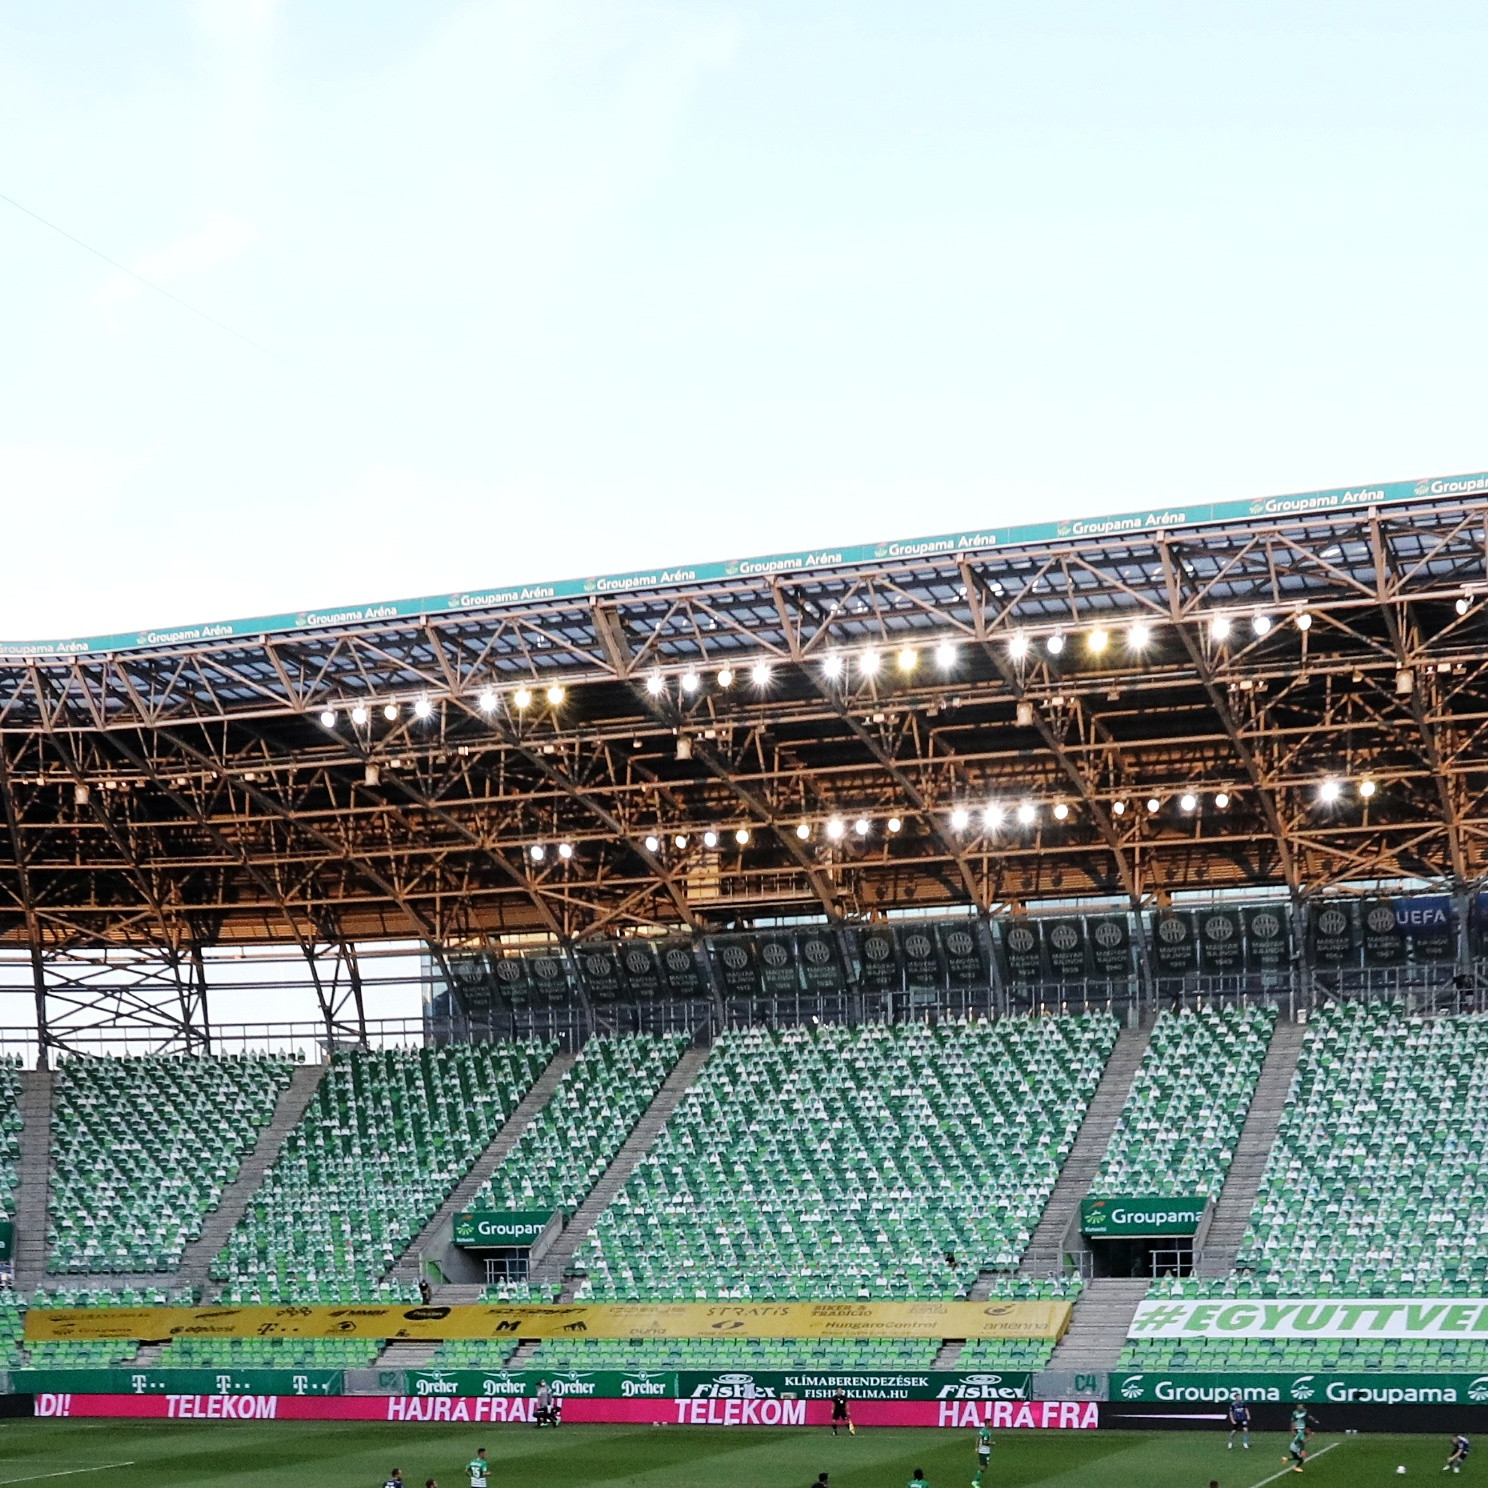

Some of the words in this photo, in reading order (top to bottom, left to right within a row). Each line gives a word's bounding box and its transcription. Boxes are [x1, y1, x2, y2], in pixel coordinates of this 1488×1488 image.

[1265, 497, 1337, 513] Groupama
[1342, 489, 1384, 504] Aréna
[1073, 519, 1141, 535] Groupama
[1144, 511, 1185, 527] Aréna
[889, 541, 954, 556] Groupama
[958, 534, 996, 548] Aréna
[740, 559, 802, 574] Groupama
[805, 552, 842, 566] Aréna
[597, 577, 656, 591] Groupama
[661, 570, 695, 584] Aréna
[461, 593, 518, 607] Groupama
[521, 587, 554, 600] Aréna
[307, 613, 362, 625] Groupama
[365, 606, 397, 618] Aréna
[148, 629, 200, 644] Groupama
[202, 625, 232, 637] Aréna
[57, 642, 89, 653] Aréna
[1396, 909, 1447, 925] UEFA
[1112, 1208, 1203, 1226] Groupama
[478, 1221, 547, 1237] Groupam
[416, 1379, 458, 1395] Dreher
[483, 1379, 526, 1395] Dreher
[552, 1379, 596, 1397] Dreher
[621, 1380, 666, 1397] Dreher
[785, 1375, 929, 1387] KLÍMABERENDEZÉSEK
[1074, 1374, 1097, 1391] C4
[936, 1385, 1025, 1399] Fisher
[1155, 1381, 1279, 1403] Groupama
[1326, 1381, 1457, 1404] Groupama
[166, 1395, 278, 1419] TELEKOM
[387, 1396, 470, 1421] HAJRÁ
[475, 1397, 562, 1423] FRAD!
[675, 1398, 807, 1425] TELEKOM
[939, 1401, 1035, 1428] HAJRÁ
